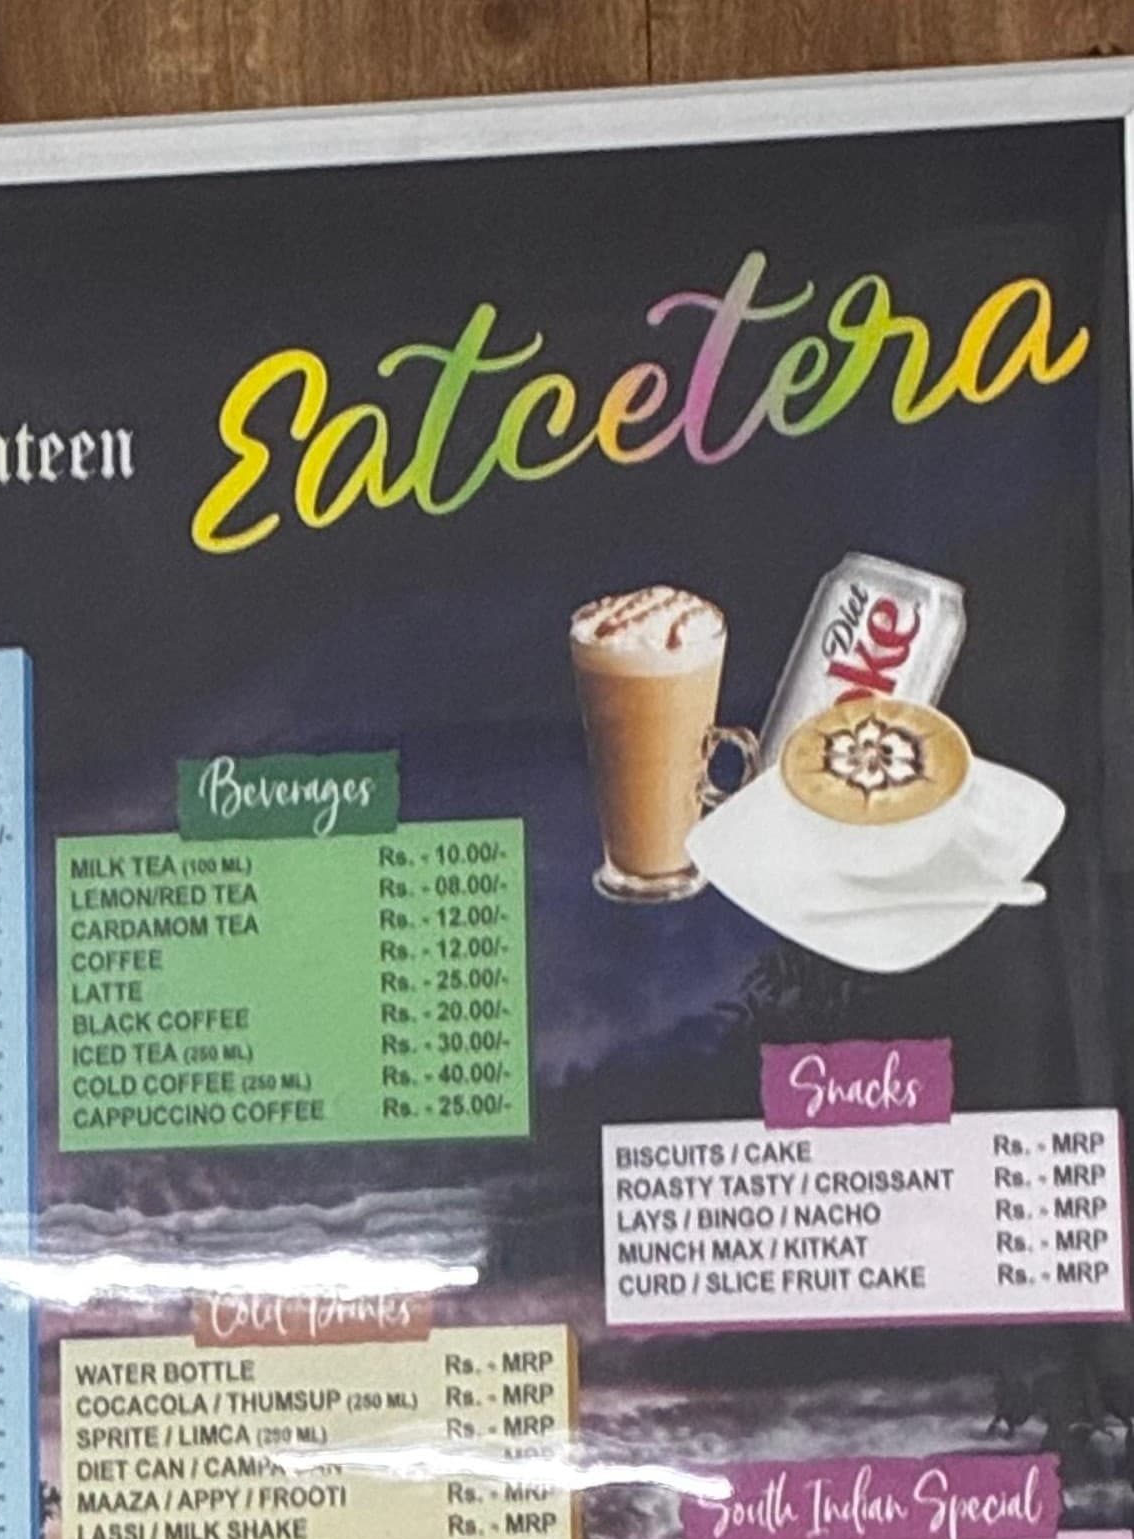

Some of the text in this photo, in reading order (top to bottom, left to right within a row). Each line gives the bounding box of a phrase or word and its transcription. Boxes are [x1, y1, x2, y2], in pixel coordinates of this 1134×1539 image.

[191, 251, 1090, 555] Eatcetera
[197, 755, 372, 837] Beverages
[71, 842, 507, 878] MILK TEA Rs. 10.00/-
[71, 882, 257, 910] LEMON/RED TEA
[71, 913, 259, 941] CARDAMOM TEA
[72, 948, 163, 972] COFFEE
[72, 981, 143, 1004] LATTE
[72, 1008, 249, 1035] BLACK COFFEE
[72, 1043, 177, 1066] ICED TEA
[73, 1072, 234, 1096] COLD COFFEE
[789, 1050, 923, 1119] Snacks
[73, 1099, 324, 1128] CAPPUCCINO COFFEE
[616, 1132, 1104, 1168] BISCUITS CAKE Rs. MRP
[617, 1168, 954, 1199] ROASTY TASTY CROISSANT
[618, 1203, 881, 1231] LAYS BINGO NACHO
[618, 1236, 868, 1263] MUNCH MAX KITKAT
[619, 1266, 926, 1295] CURD SLICE FRUIT CAKE
[76, 1351, 553, 1384] WATER BOTTLE Rs. MRP
[76, 1391, 340, 1416] COCACOLA THUMSUP
[77, 1425, 250, 1447] SPRITE LIMCA
[77, 1485, 346, 1513] MAAZA APPY FROOTI
[697, 1470, 799, 1539] South
[802, 1464, 908, 1539] Indian
